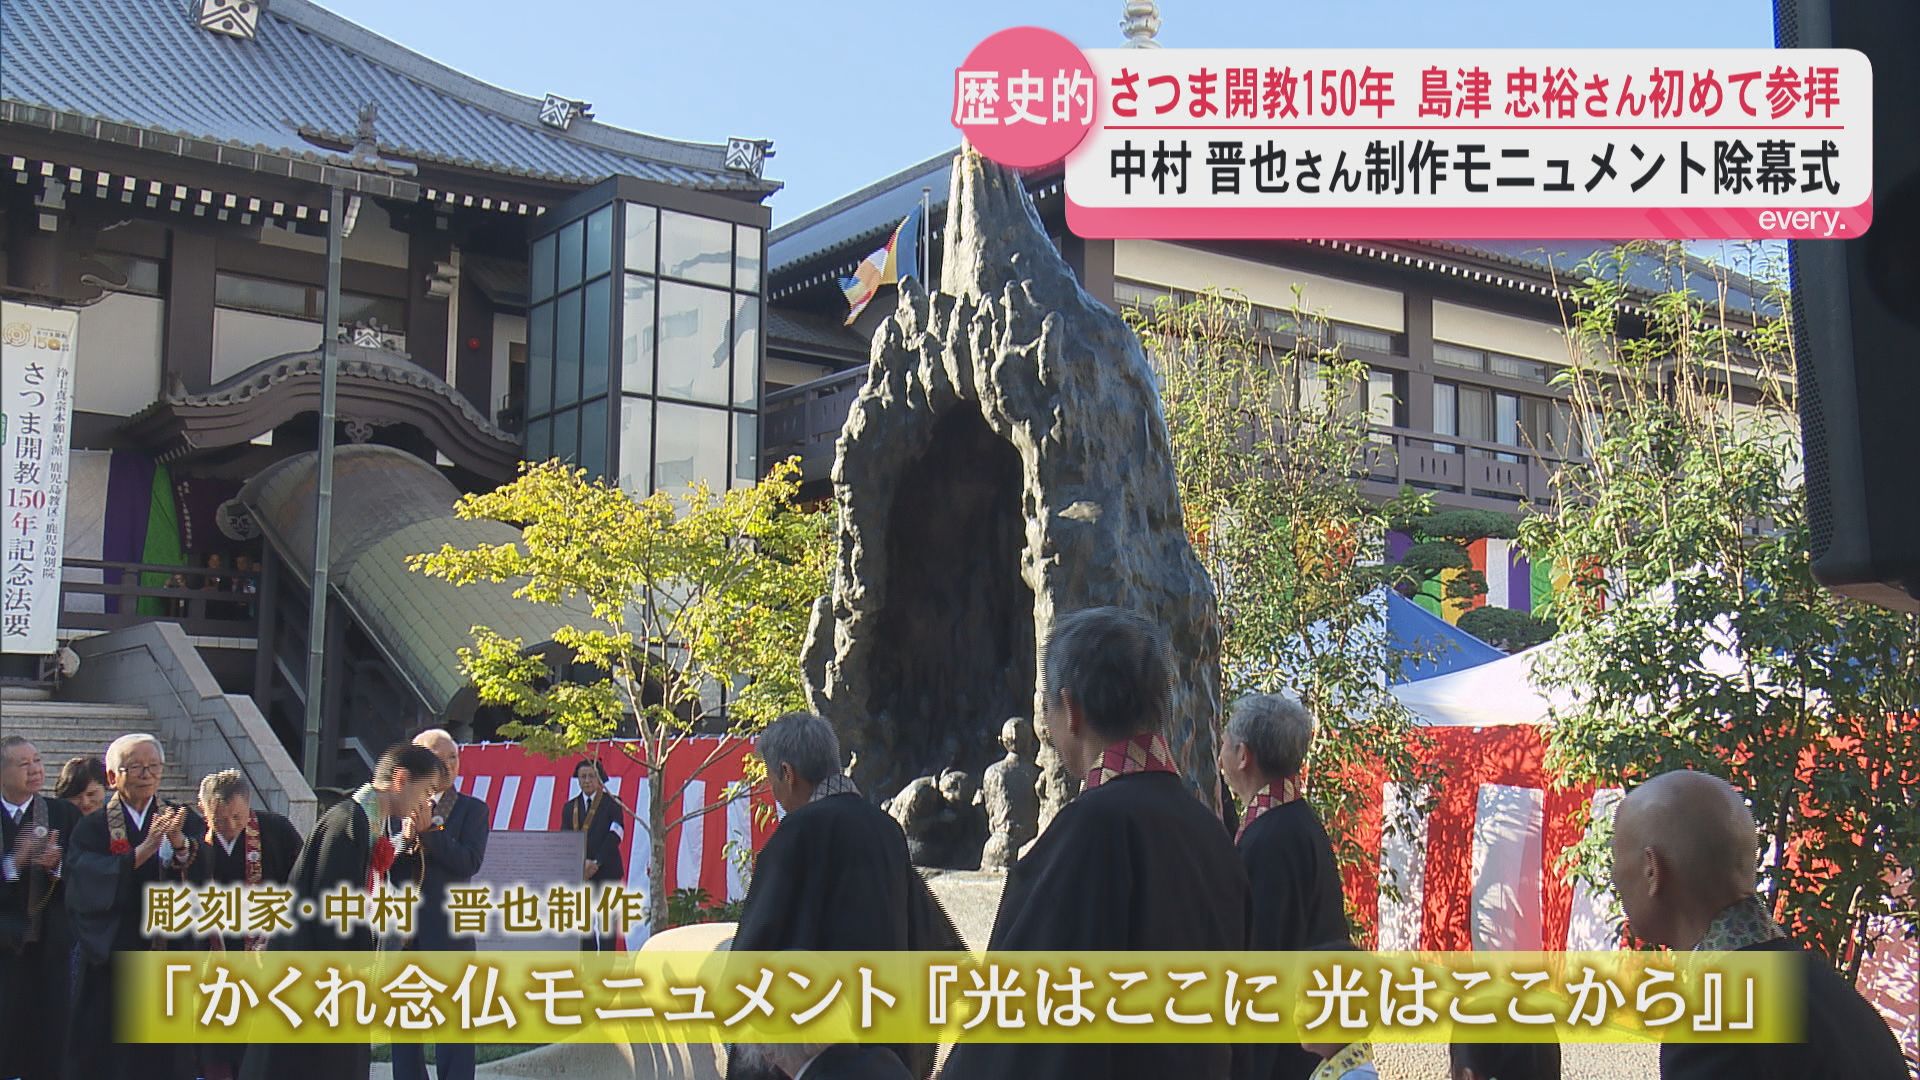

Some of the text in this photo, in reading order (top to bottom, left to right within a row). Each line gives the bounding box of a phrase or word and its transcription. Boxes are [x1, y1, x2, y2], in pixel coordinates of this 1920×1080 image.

[4, 361, 46, 637] さつま開教150年記念法要
